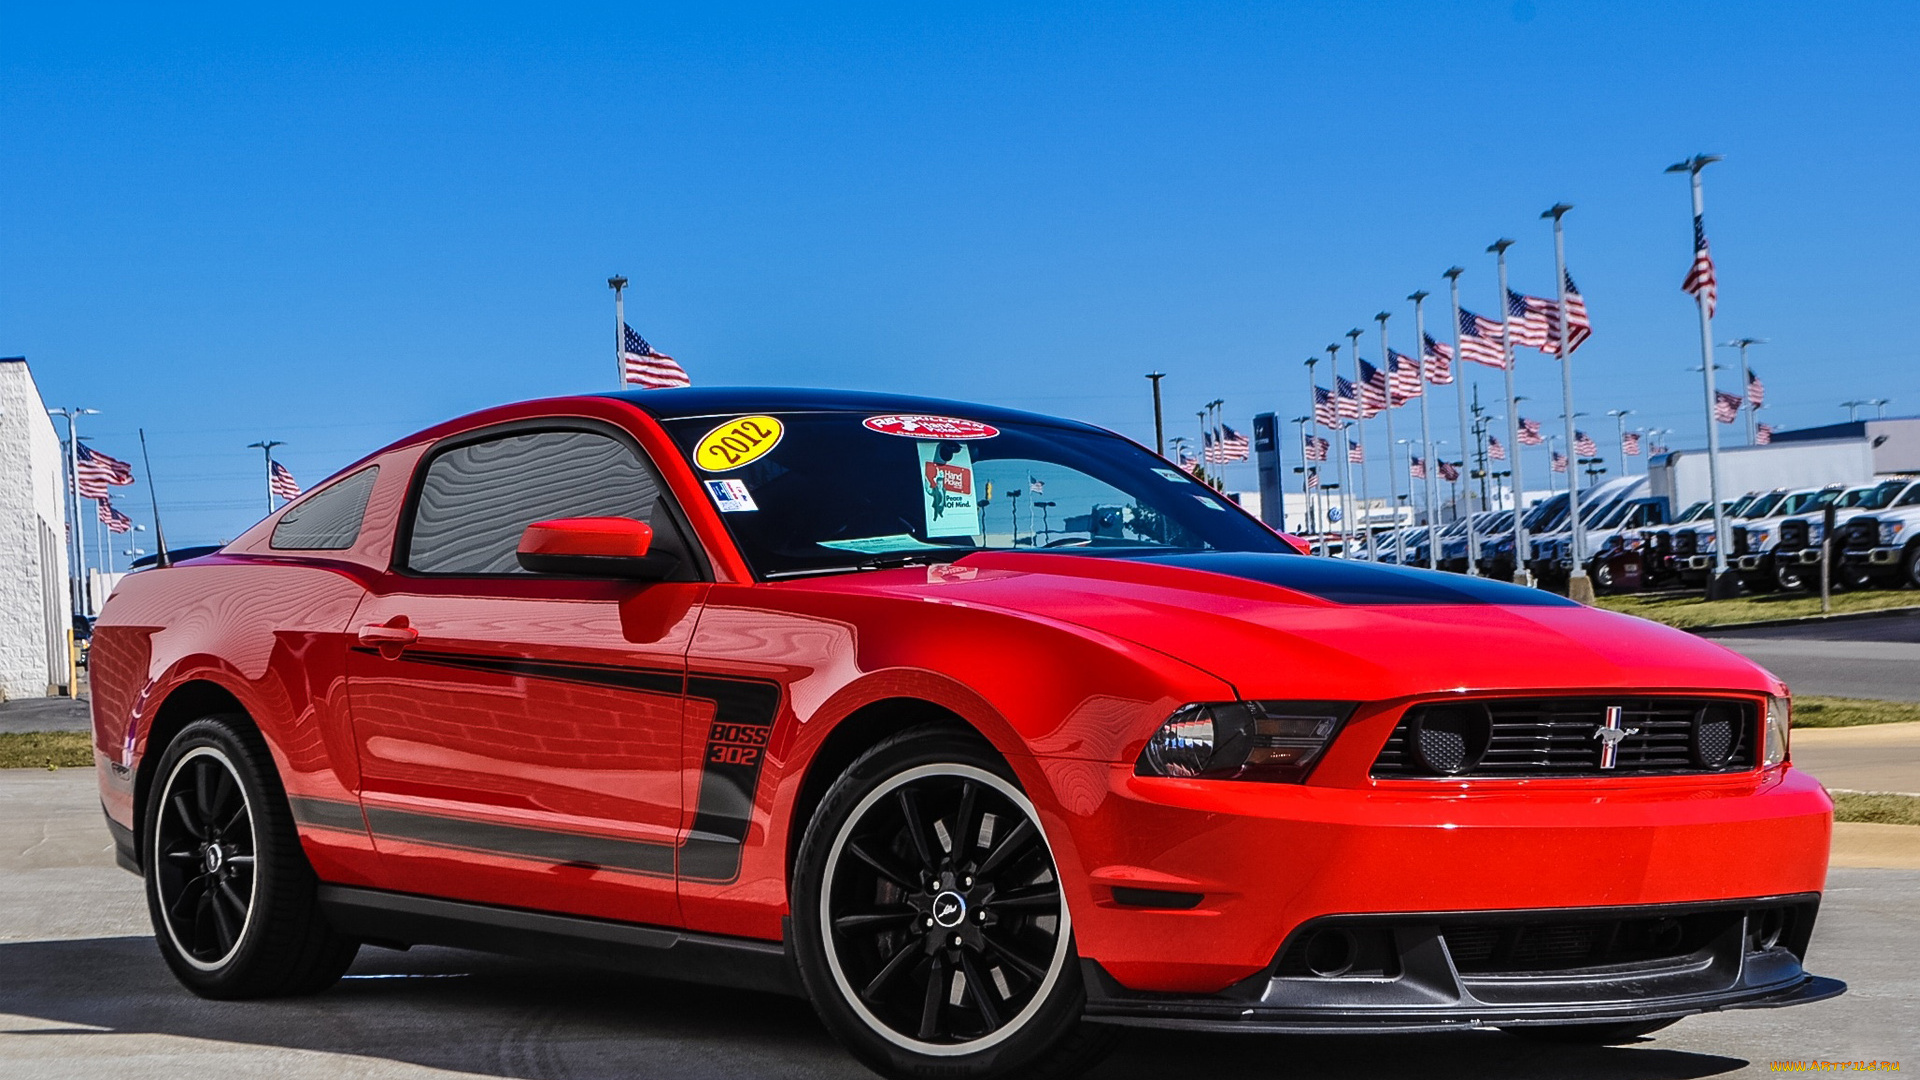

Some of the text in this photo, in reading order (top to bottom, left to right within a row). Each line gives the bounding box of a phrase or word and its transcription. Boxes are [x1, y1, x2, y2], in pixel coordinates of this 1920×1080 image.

[709, 421, 772, 464] 2012
[944, 469, 963, 481] Hand
[710, 724, 769, 744] BOSS
[711, 745, 758, 766] 302
